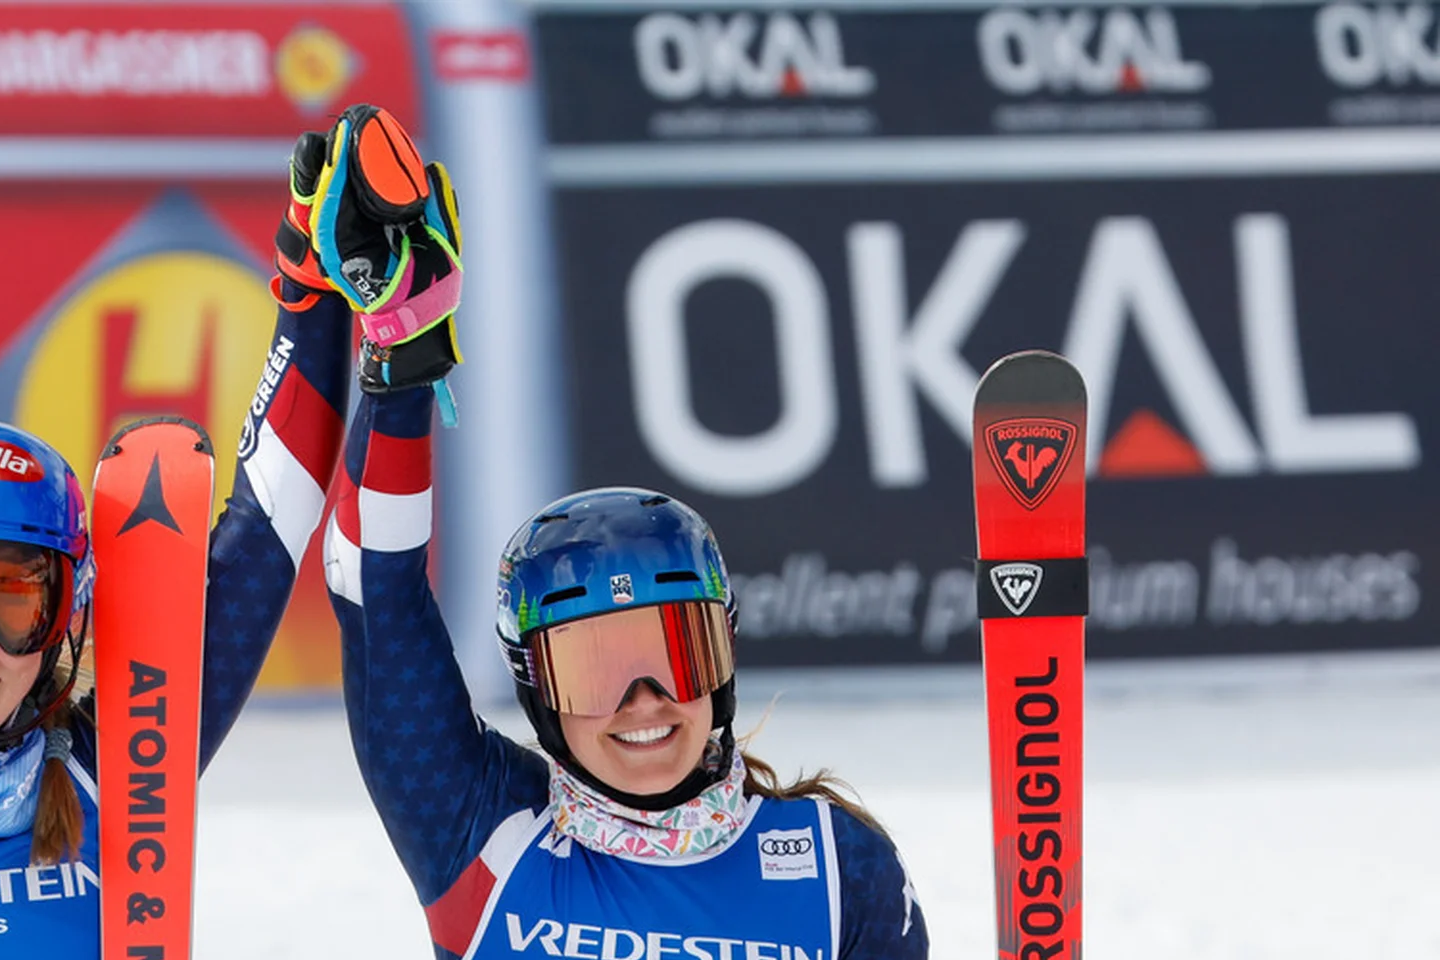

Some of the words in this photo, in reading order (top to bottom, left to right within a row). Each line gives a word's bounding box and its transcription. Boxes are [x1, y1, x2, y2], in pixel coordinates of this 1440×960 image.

[634, 11, 876, 100] OKAL
[976, 8, 1212, 93] OKAL
[1315, 3, 1440, 90] OK
[626, 214, 1422, 497] OKAL
[997, 426, 1064, 441] ROSSIGNOL
[126, 659, 168, 876] ATOMIC
[126, 892, 166, 927] &
